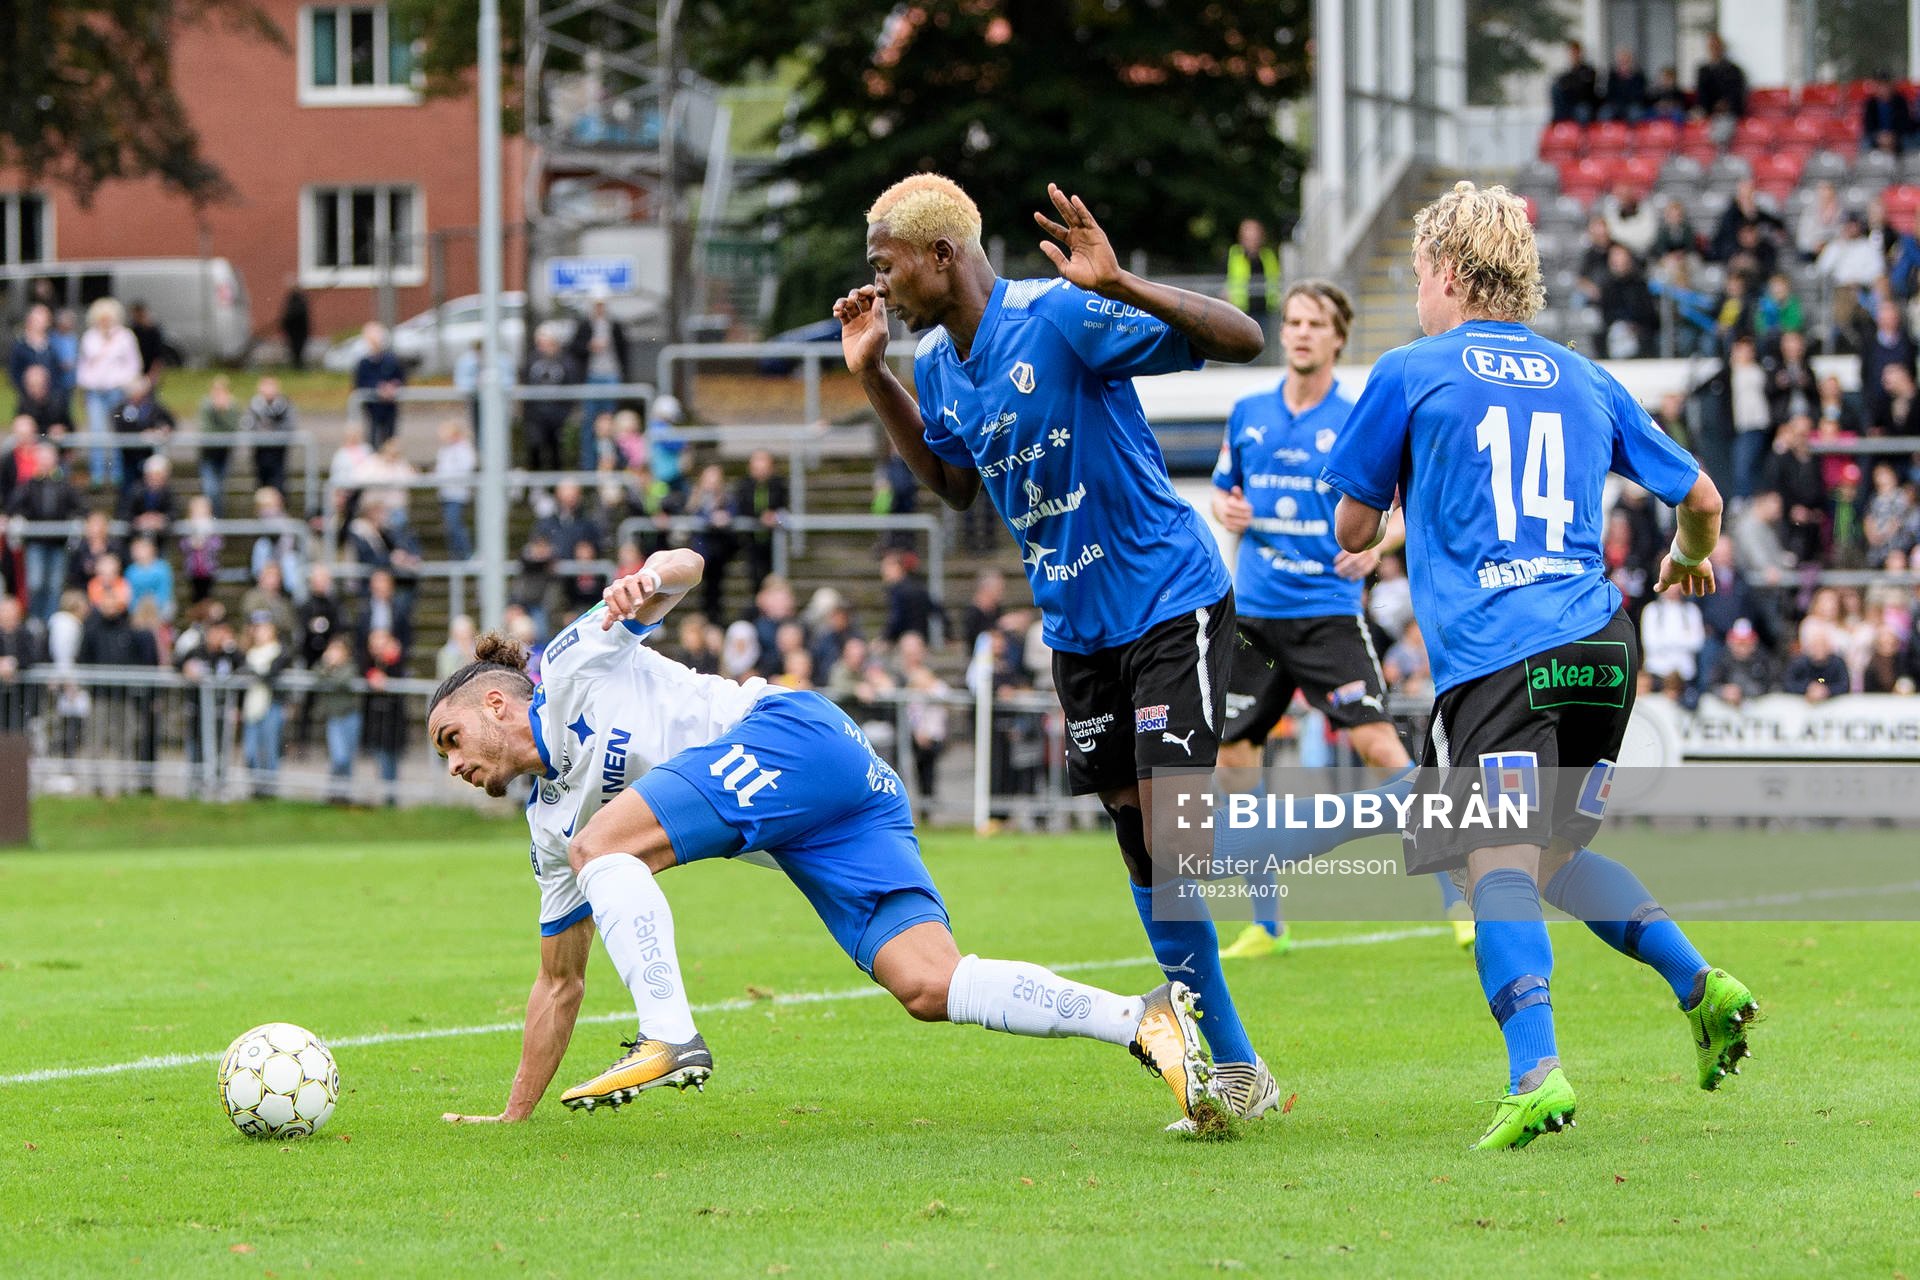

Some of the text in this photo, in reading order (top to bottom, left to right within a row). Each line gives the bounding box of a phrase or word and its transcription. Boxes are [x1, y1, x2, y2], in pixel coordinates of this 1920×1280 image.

[1471, 349, 1551, 383] EAB
[977, 443, 1046, 478] GETINGE
[1475, 405, 1574, 552] 14
[1043, 543, 1105, 582] bravida
[1531, 658, 1594, 690] akea
[1136, 705, 1167, 721] NTER
[1069, 724, 1107, 738] adsnät
